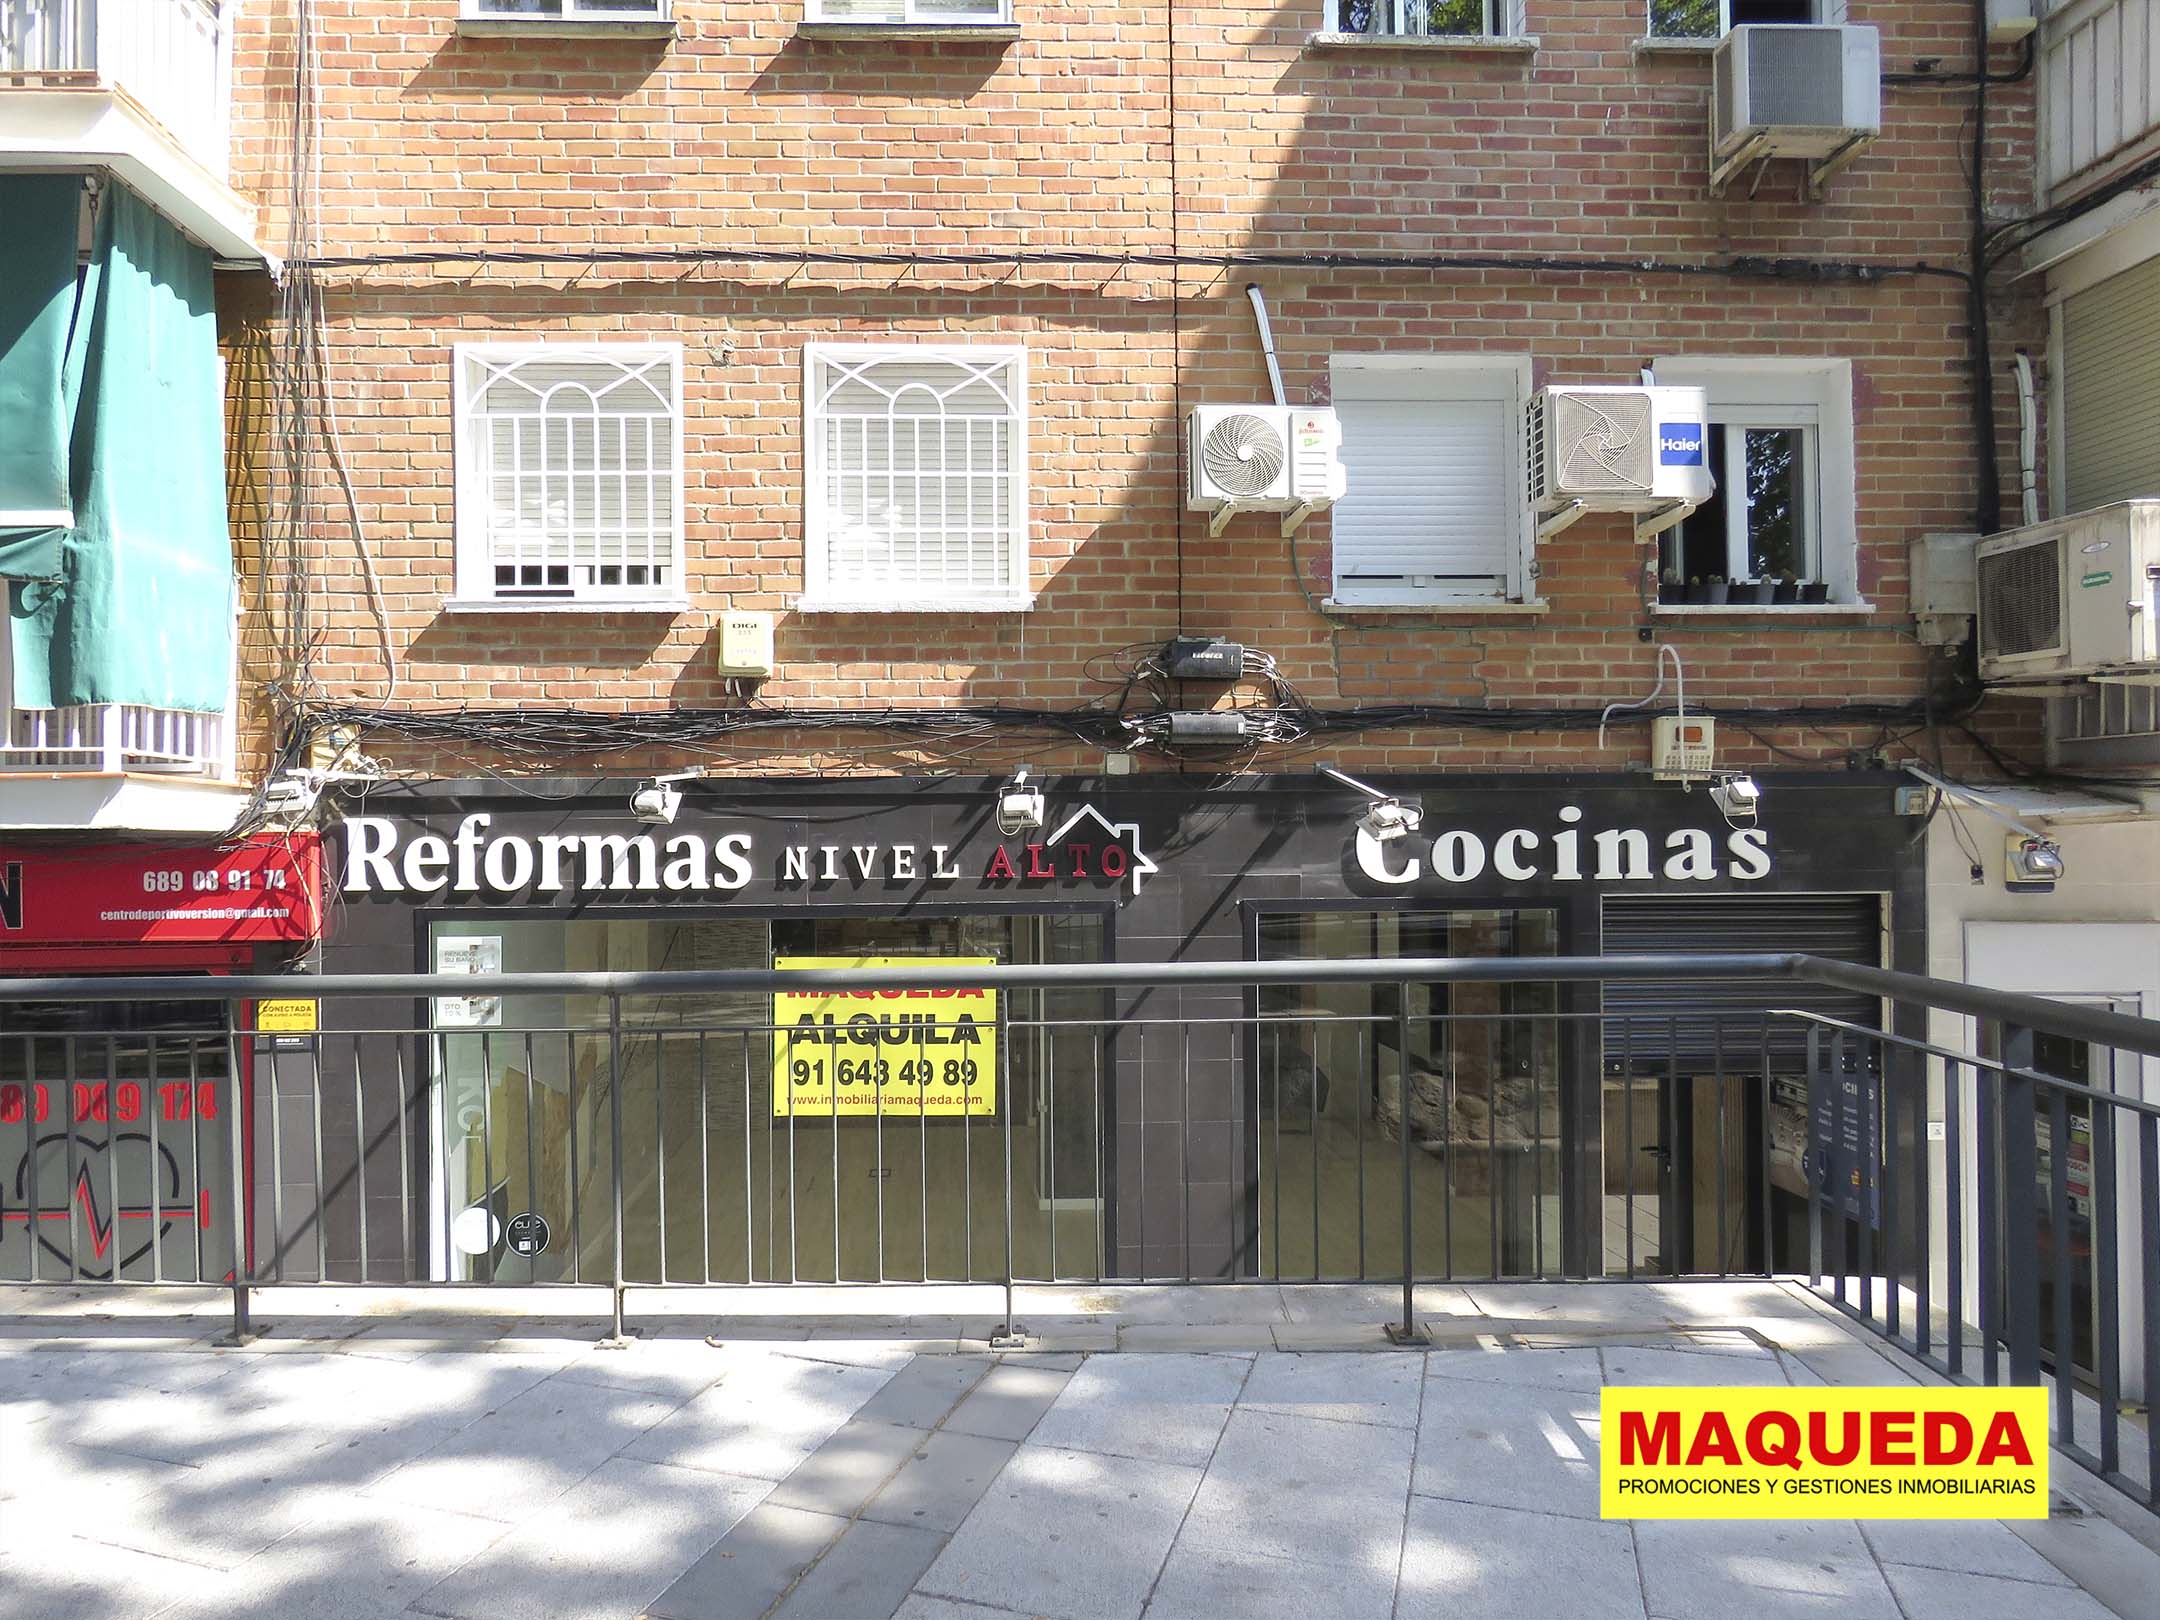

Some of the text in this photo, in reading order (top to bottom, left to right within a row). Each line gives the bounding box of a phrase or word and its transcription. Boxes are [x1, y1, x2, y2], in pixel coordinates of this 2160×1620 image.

[1661, 437, 1701, 451] Haier
[342, 813, 753, 892] Reformas
[783, 843, 1128, 880] NIVEL ALTO
[1354, 806, 1772, 884] Cocinas
[143, 869, 287, 892] 689 08 91 74
[790, 1013, 981, 1047] ALQUILA
[793, 1059, 978, 1086] 91 643 49 89
